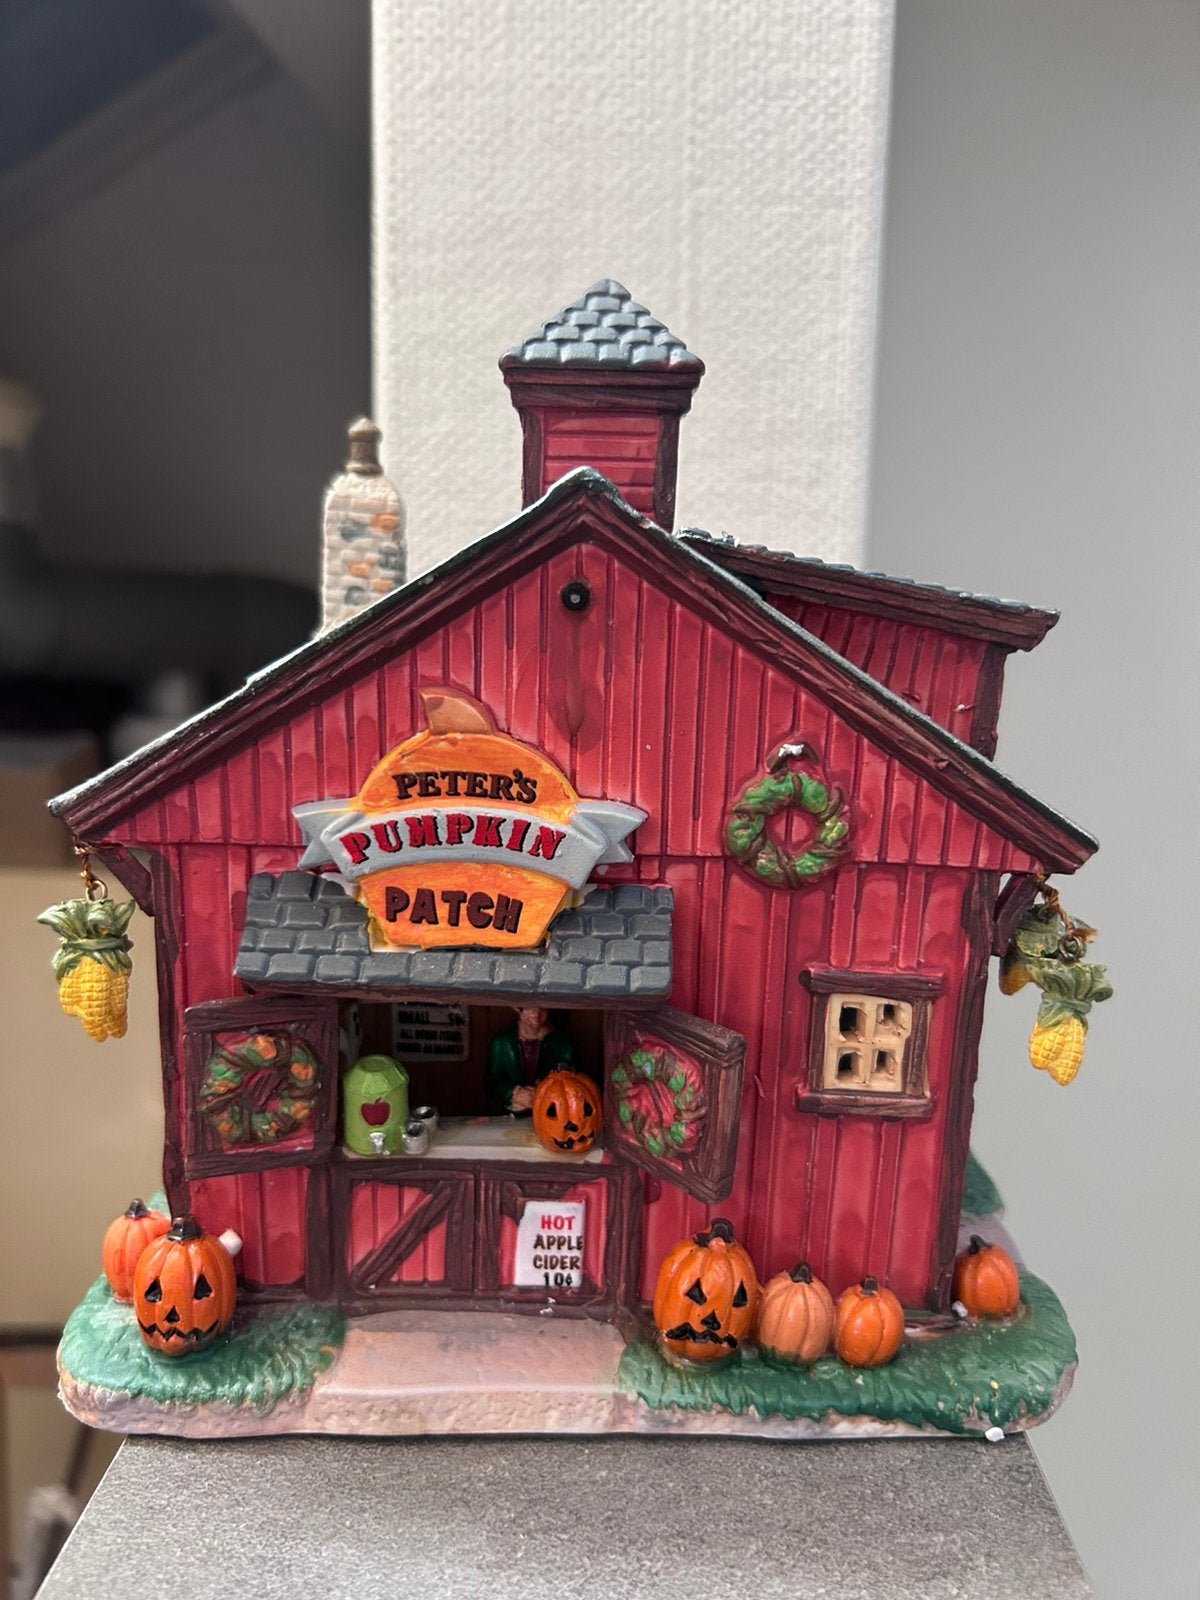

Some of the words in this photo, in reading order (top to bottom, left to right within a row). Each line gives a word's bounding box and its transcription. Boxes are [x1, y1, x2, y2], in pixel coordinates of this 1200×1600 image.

[392, 768, 538, 804] PETER'S
[339, 813, 566, 865] PUMPKIN
[384, 886, 524, 934] PATCH
[541, 1215, 575, 1230] HOT
[533, 1234, 583, 1250] APPLE
[533, 1255, 580, 1270] CIDER
